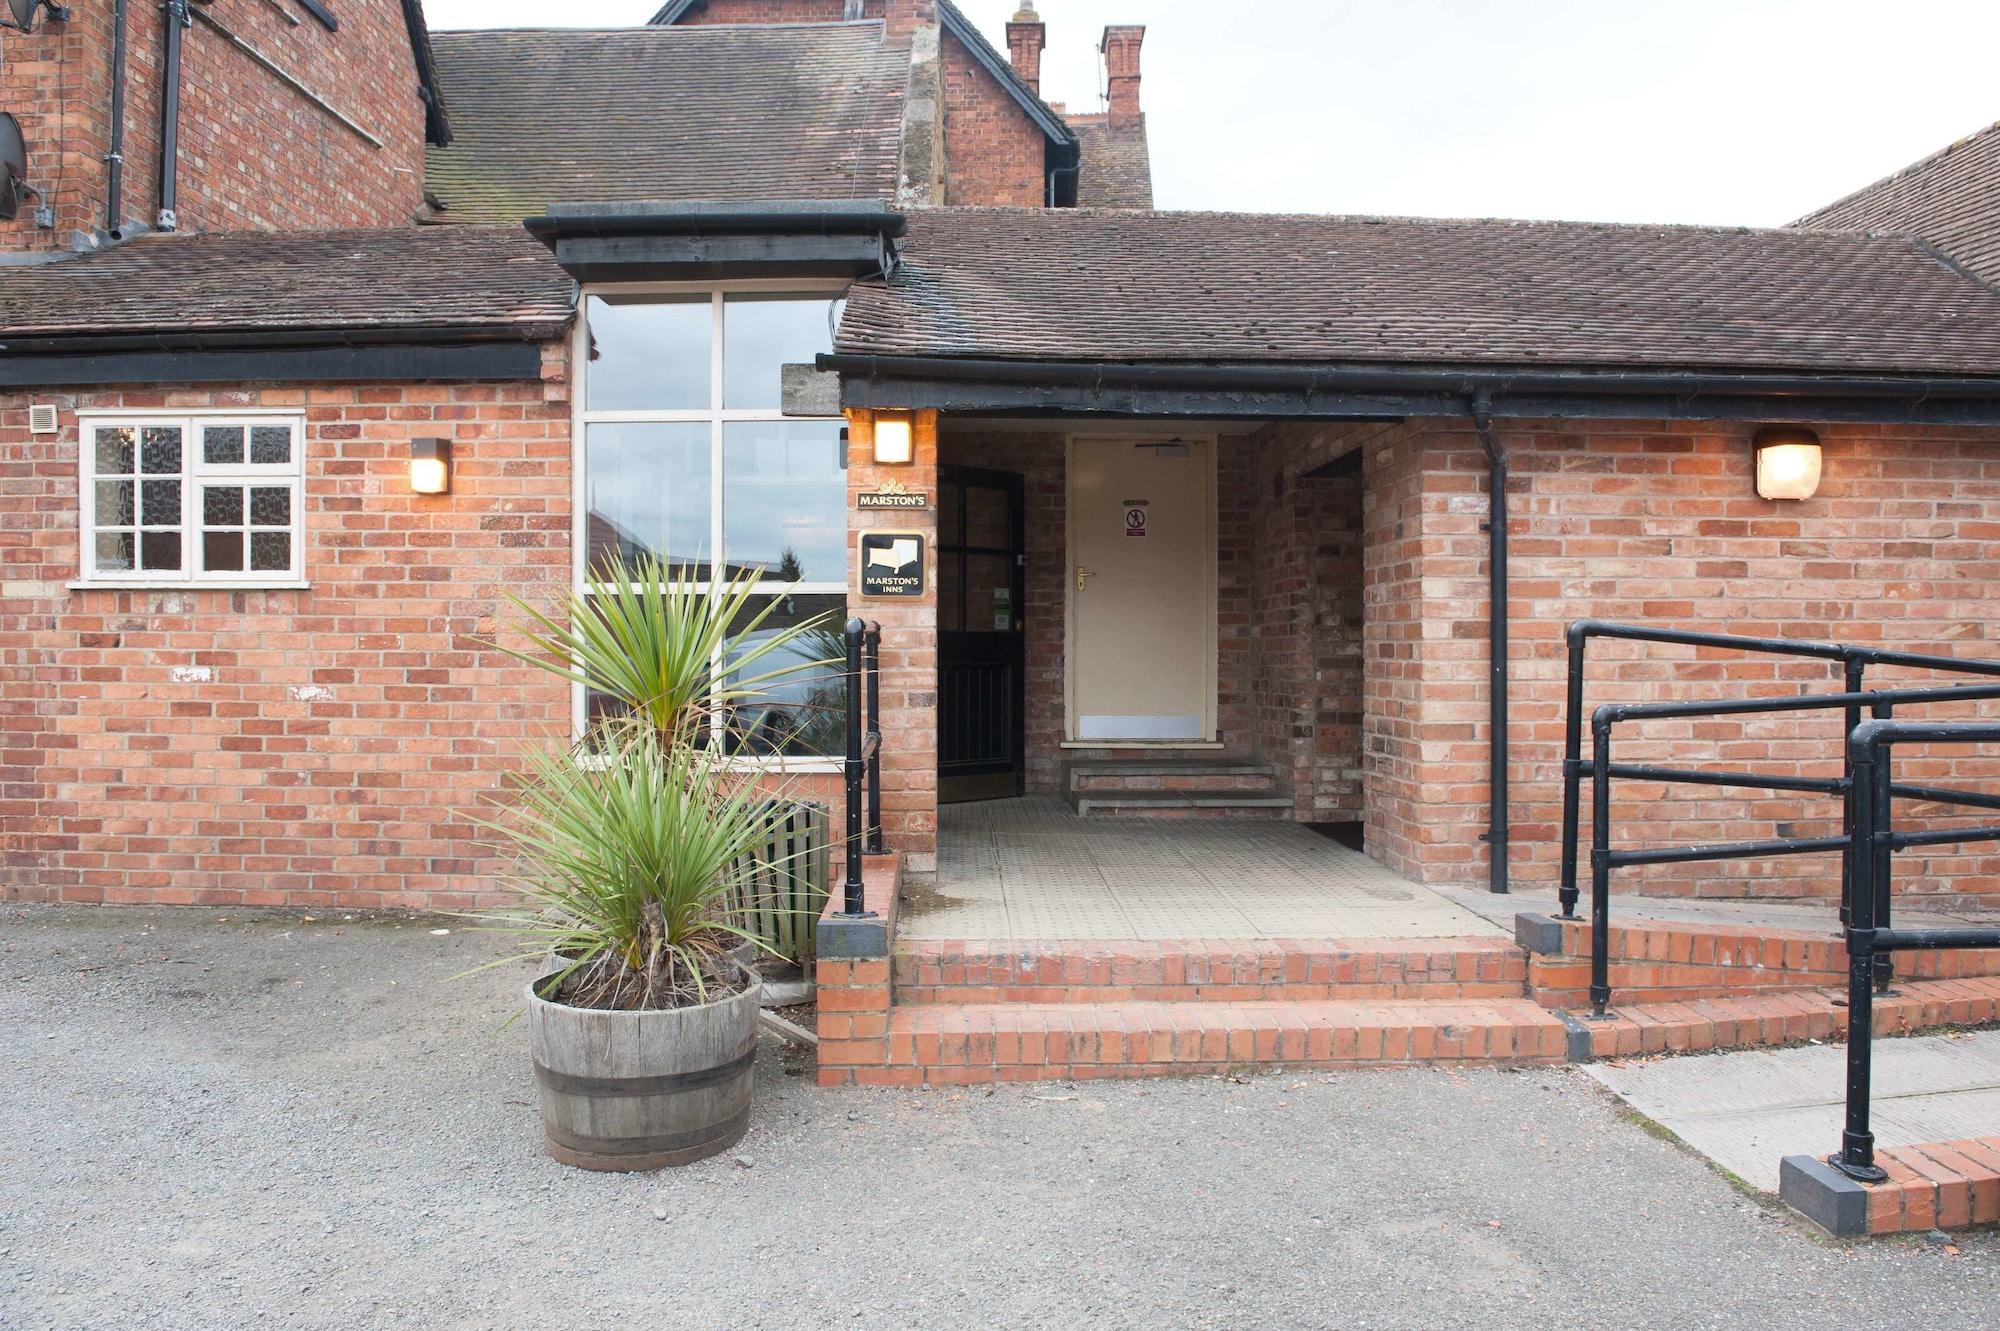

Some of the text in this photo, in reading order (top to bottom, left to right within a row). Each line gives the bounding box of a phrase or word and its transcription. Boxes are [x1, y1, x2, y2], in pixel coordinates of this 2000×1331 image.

[860, 496, 925, 506] MARSTON'S
[866, 577, 919, 585] MARSTON'S
[882, 585, 904, 593] INNS
